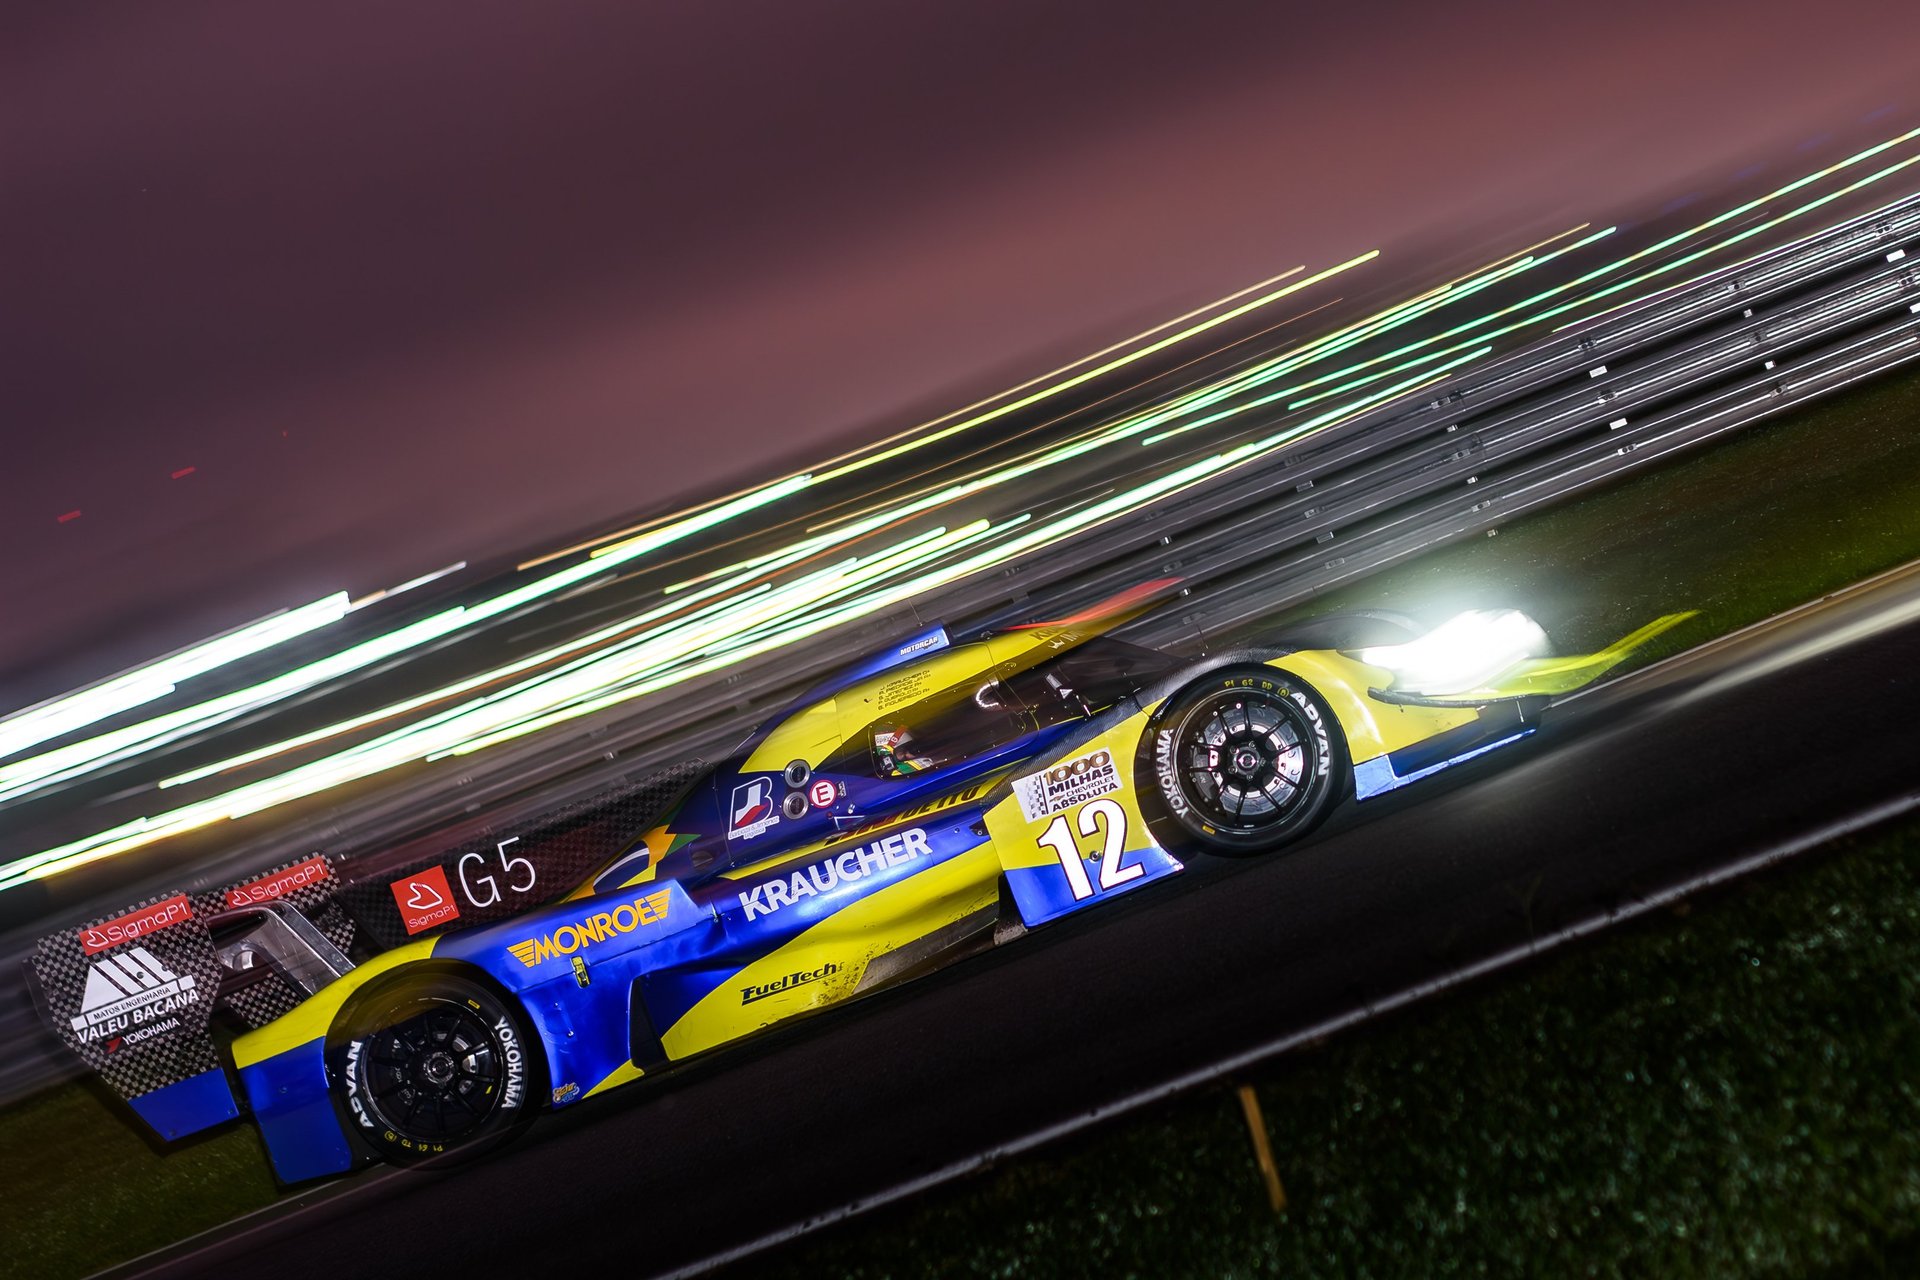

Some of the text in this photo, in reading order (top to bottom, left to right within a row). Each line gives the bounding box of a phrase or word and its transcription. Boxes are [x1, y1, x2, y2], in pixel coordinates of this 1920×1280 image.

[900, 636, 939, 656] MOTORCAR
[1224, 679, 1235, 688] P1
[1291, 692, 1330, 776] ADVAN
[1043, 751, 1110, 786] 1000
[1048, 764, 1114, 797] MILHAS
[1066, 774, 1115, 797] CHEVROLET
[1156, 728, 1188, 819] YOKOHAMA
[815, 784, 831, 804] E
[1052, 782, 1119, 813] ABSOLUTA
[1036, 798, 1148, 902] 12
[251, 863, 324, 899] SigmaP1
[458, 836, 537, 909] G5
[738, 827, 933, 922] KRAUCHER
[107, 902, 189, 942] SigmaP1
[408, 904, 457, 929] SigmaP1
[534, 896, 660, 966] MONROE
[740, 962, 837, 1001] FuelTech
[77, 989, 200, 1045] VALEU BACANA
[93, 986, 172, 1020] MATOS ENGENHARIA
[122, 1017, 181, 1047] YOKOHAMA
[494, 1016, 524, 1109] YOKOHAMA
[345, 1040, 375, 1128] ADVAN
